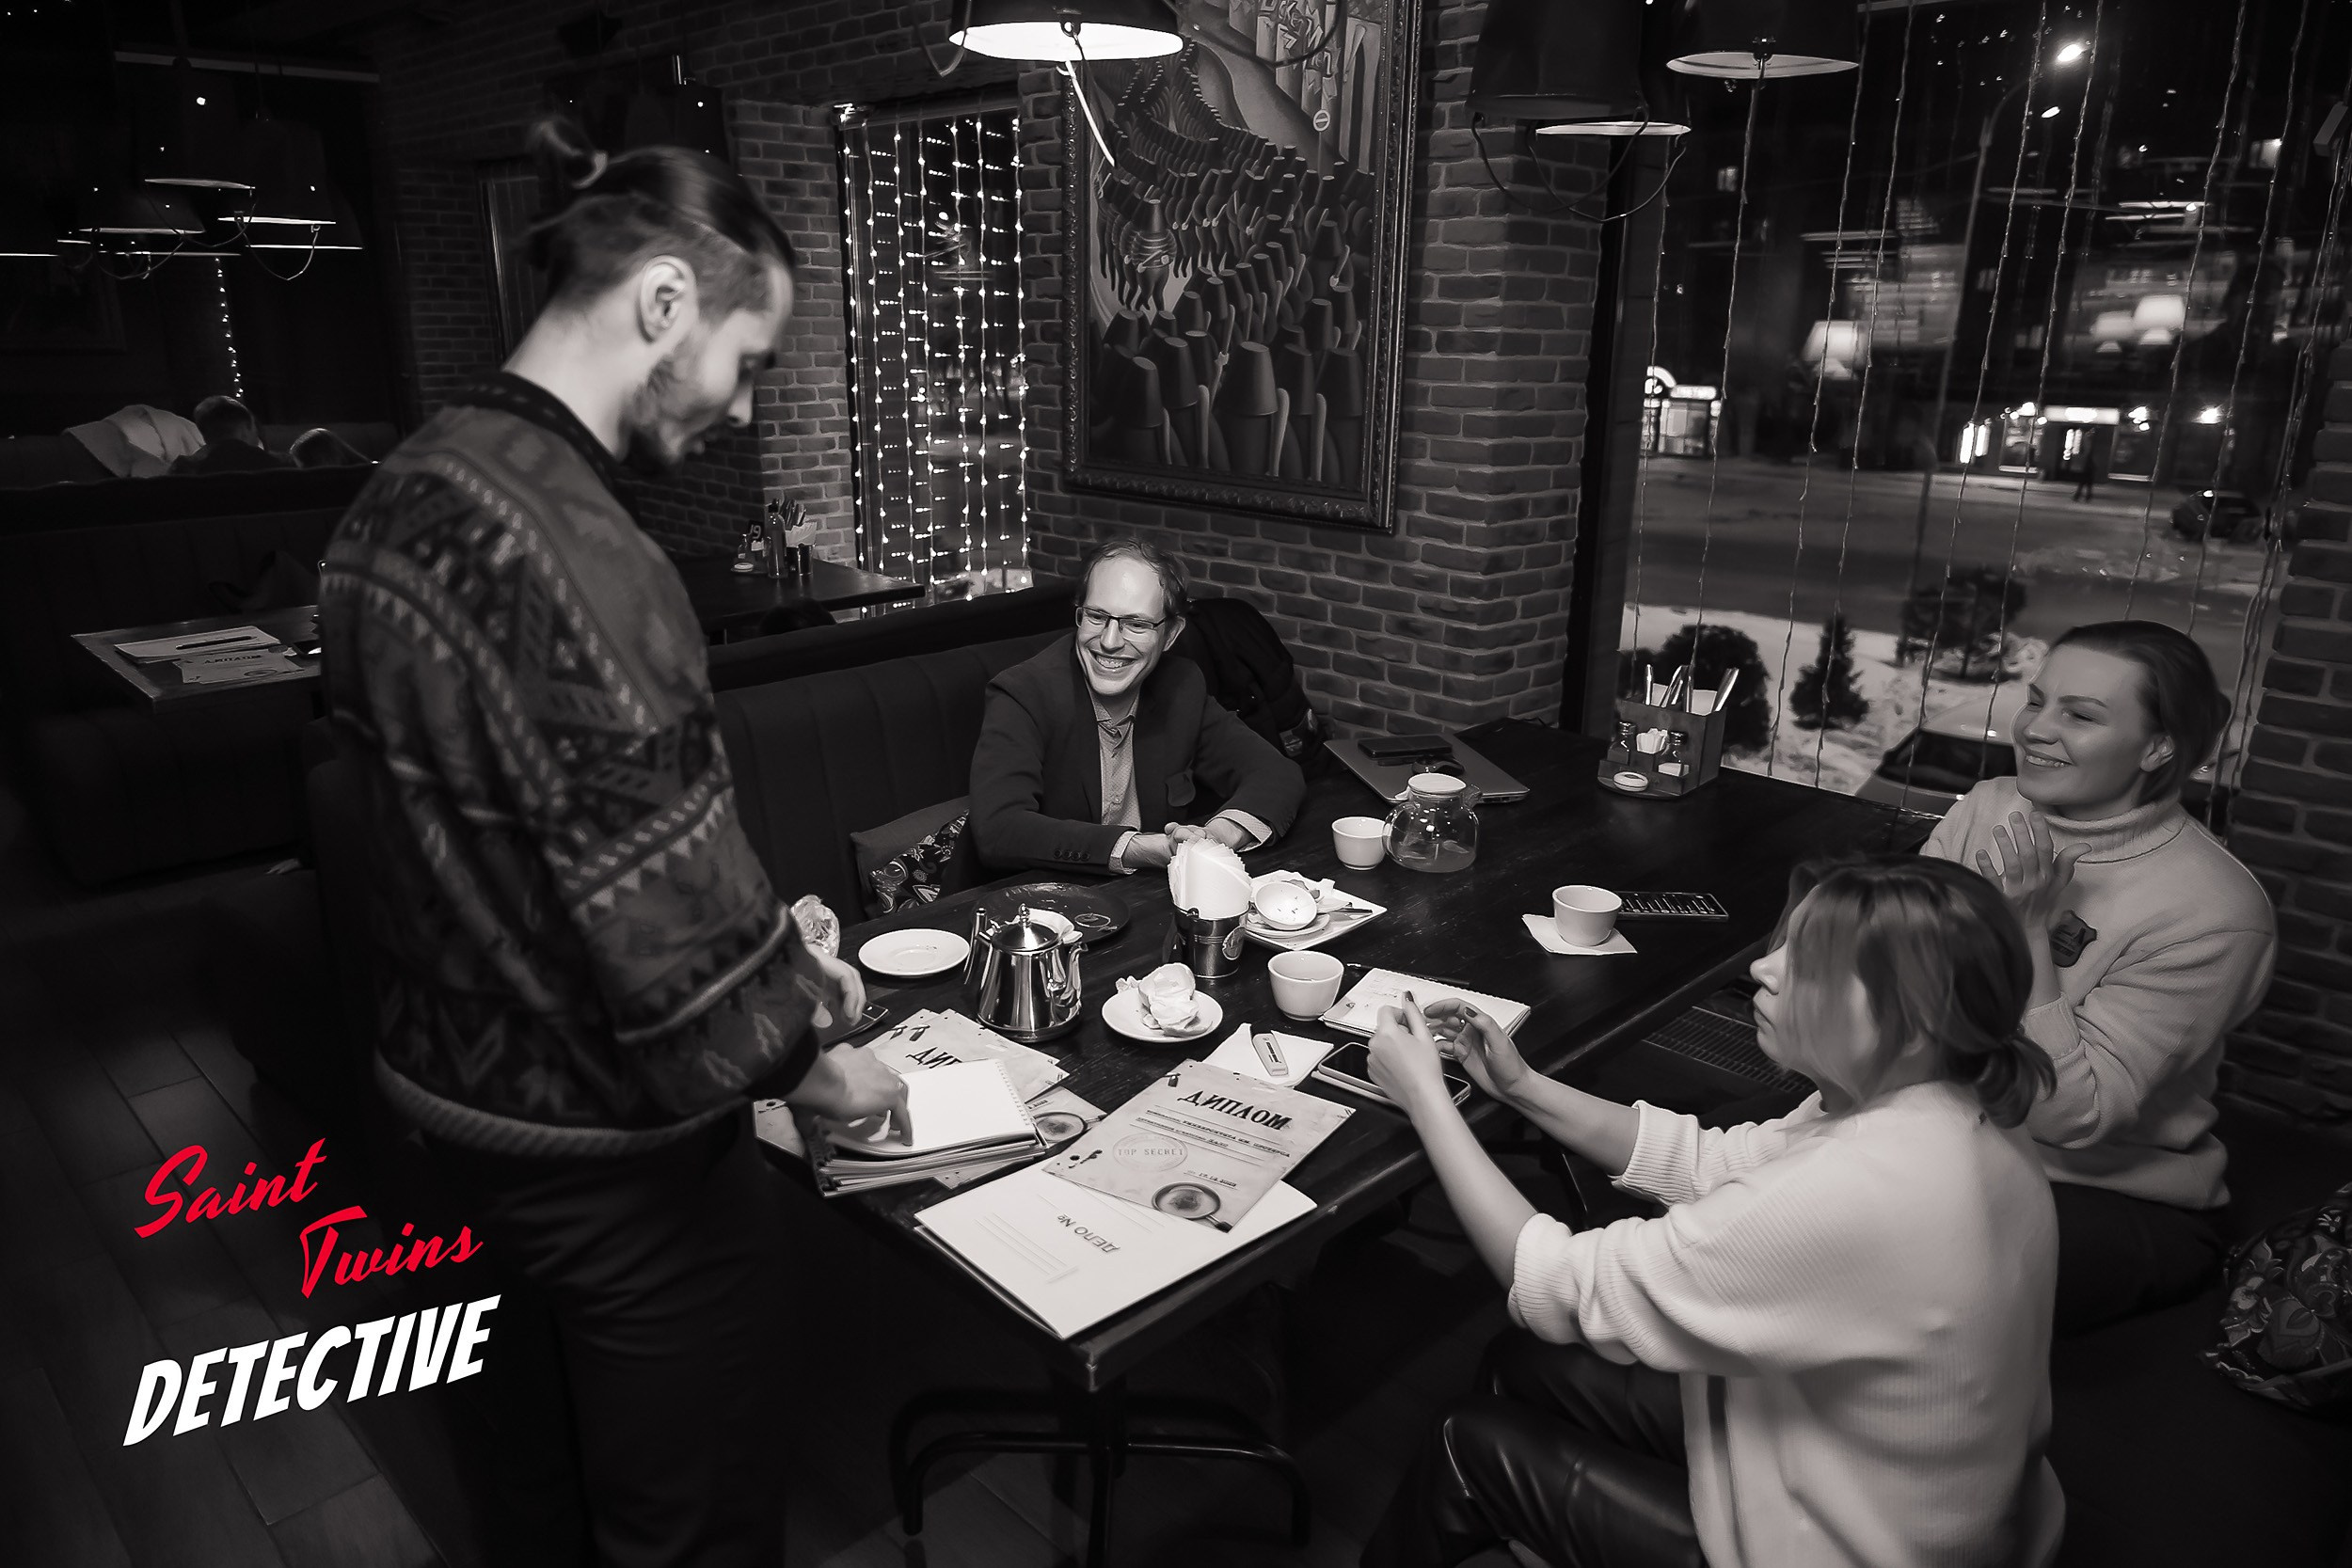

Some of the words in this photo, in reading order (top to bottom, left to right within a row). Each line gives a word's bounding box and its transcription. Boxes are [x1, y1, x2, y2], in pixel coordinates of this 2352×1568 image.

[1177, 1090, 1293, 1130] ДИПЛОМ
[1118, 1148, 1137, 1156] TOP
[1144, 1148, 1184, 1156] SECRET
[1074, 1226, 1120, 1253] ДЕЛО
